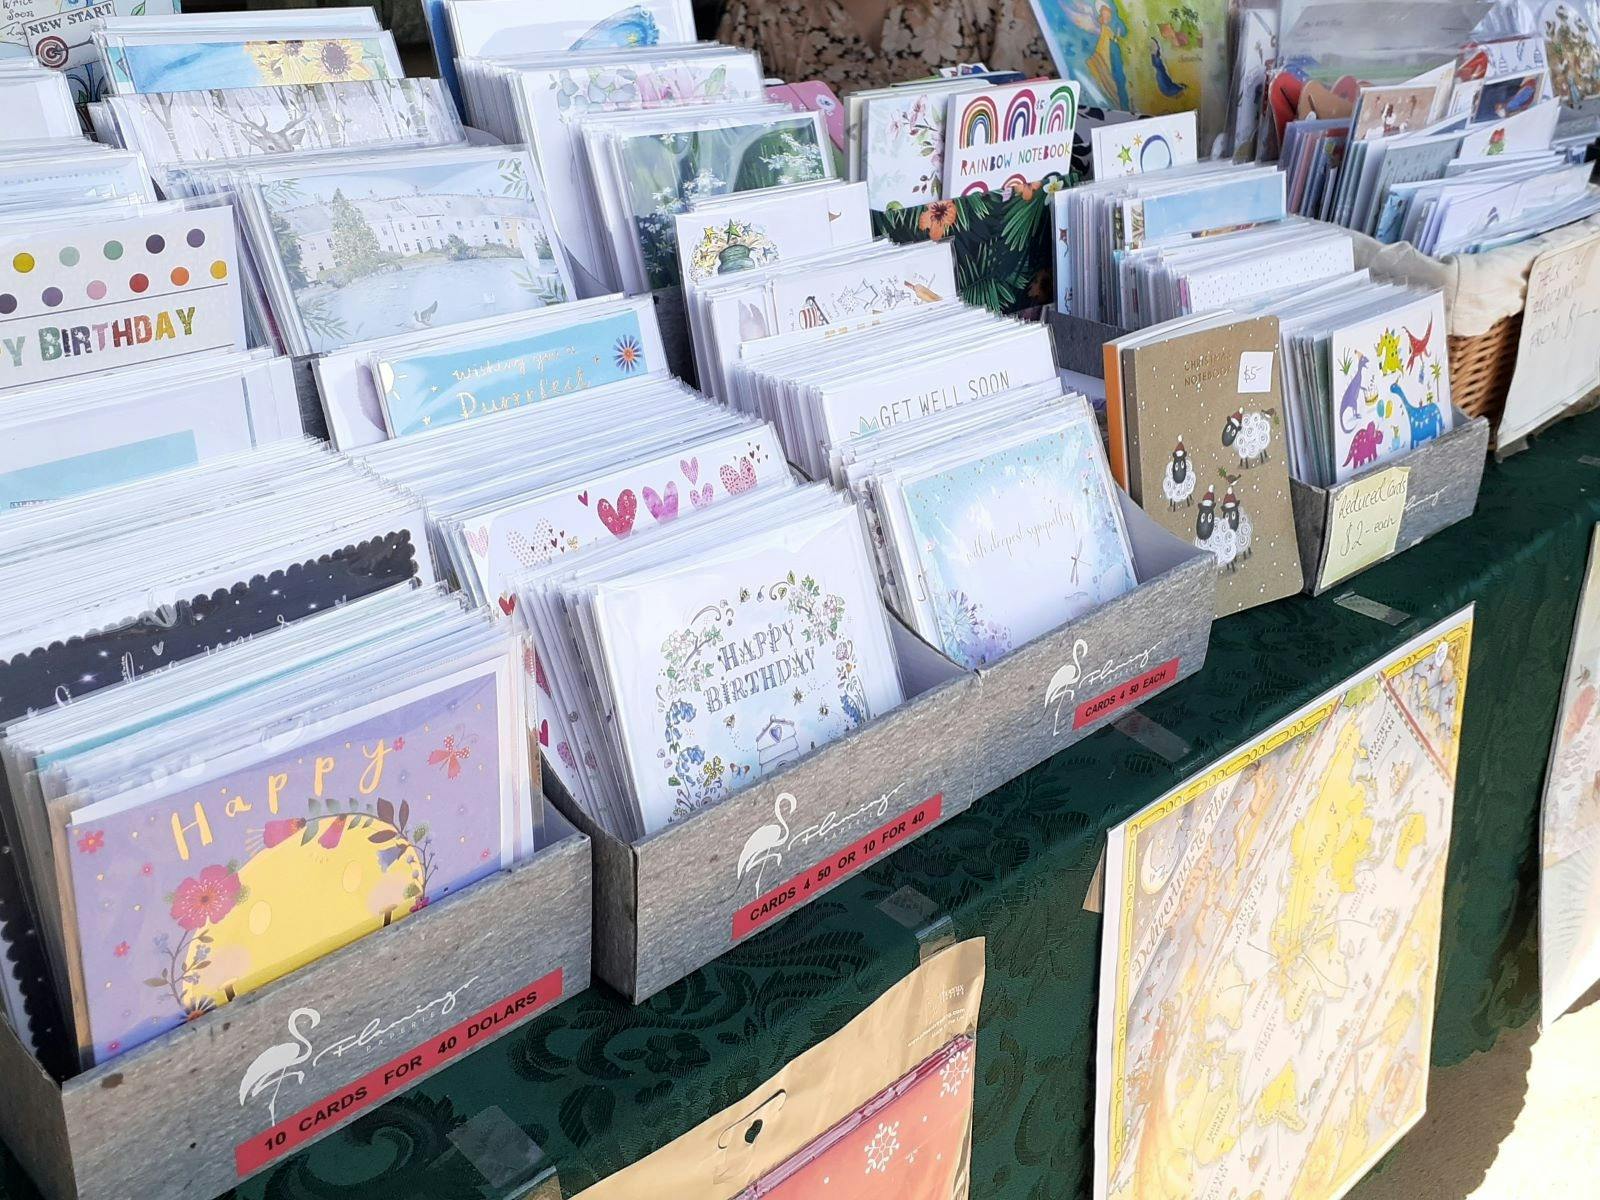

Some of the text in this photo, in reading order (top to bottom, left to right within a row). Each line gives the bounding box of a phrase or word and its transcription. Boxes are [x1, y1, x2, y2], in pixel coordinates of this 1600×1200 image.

[27, 3, 113, 36] NEW START
[960, 142, 1071, 176] RAINBOW NOTEBOOK
[38, 306, 196, 361] BIRTHDAY
[879, 369, 1011, 431] GET WELL SOON
[718, 620, 794, 673] HAPPY
[703, 646, 816, 714] BIRTHDAY
[1085, 696, 1115, 717] CARDS
[1119, 690, 1125, 700] 4
[1129, 683, 1139, 695] 50
[1143, 669, 1167, 689] EACH
[171, 738, 393, 861] Happy
[750, 810, 925, 921] CARDS 4 50 OR 10 FOR 40
[1131, 858, 1193, 980] Delivering
[366, 1011, 436, 1053] PAPERIE
[263, 991, 538, 1152] 10 CARDS FOR 40 DOLARS
